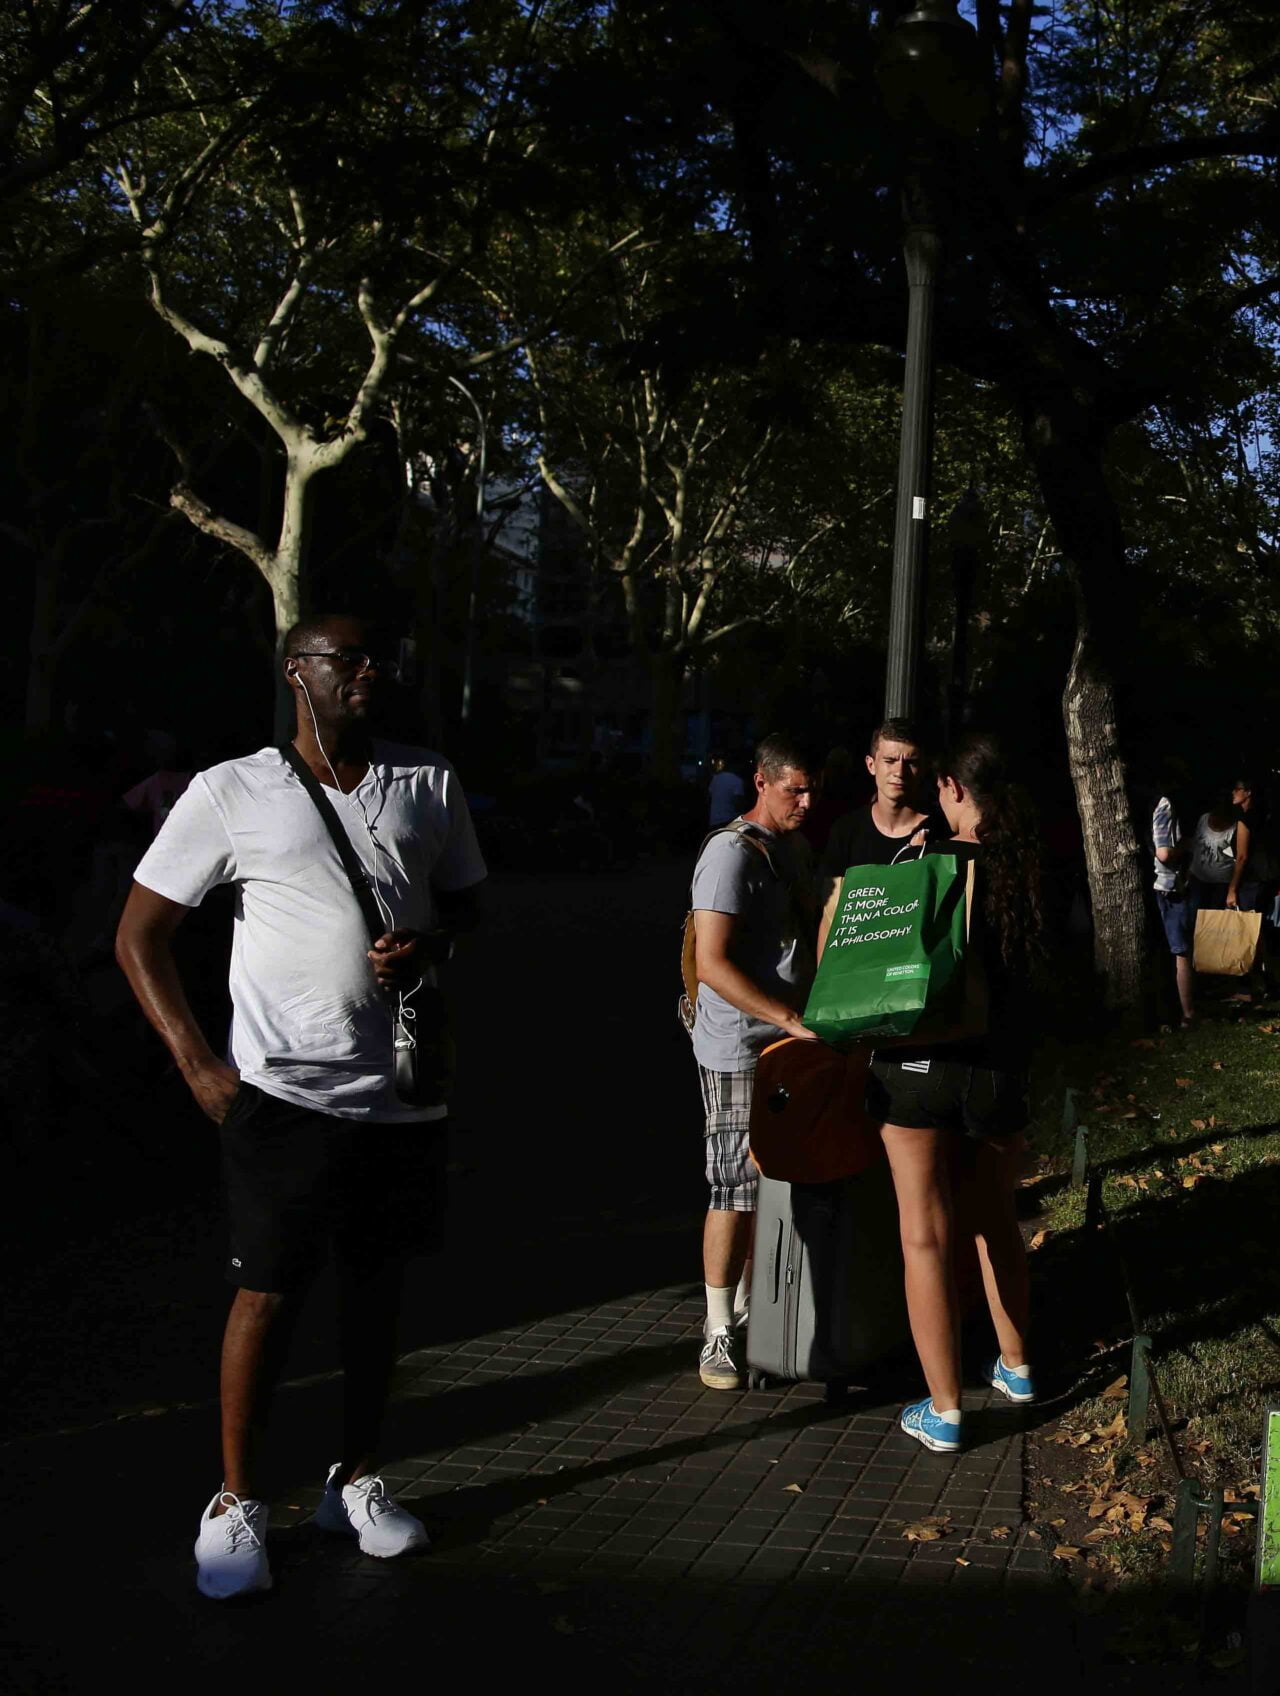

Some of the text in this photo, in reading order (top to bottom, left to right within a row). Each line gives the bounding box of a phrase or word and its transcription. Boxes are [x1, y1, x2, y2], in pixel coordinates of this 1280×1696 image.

[848, 887, 886, 899] GREEN
[843, 897, 890, 912] IS MORE
[841, 911, 873, 925] THAN
[872, 910, 881, 920] A
[835, 925, 858, 937] IT IS
[828, 939, 839, 949] A
